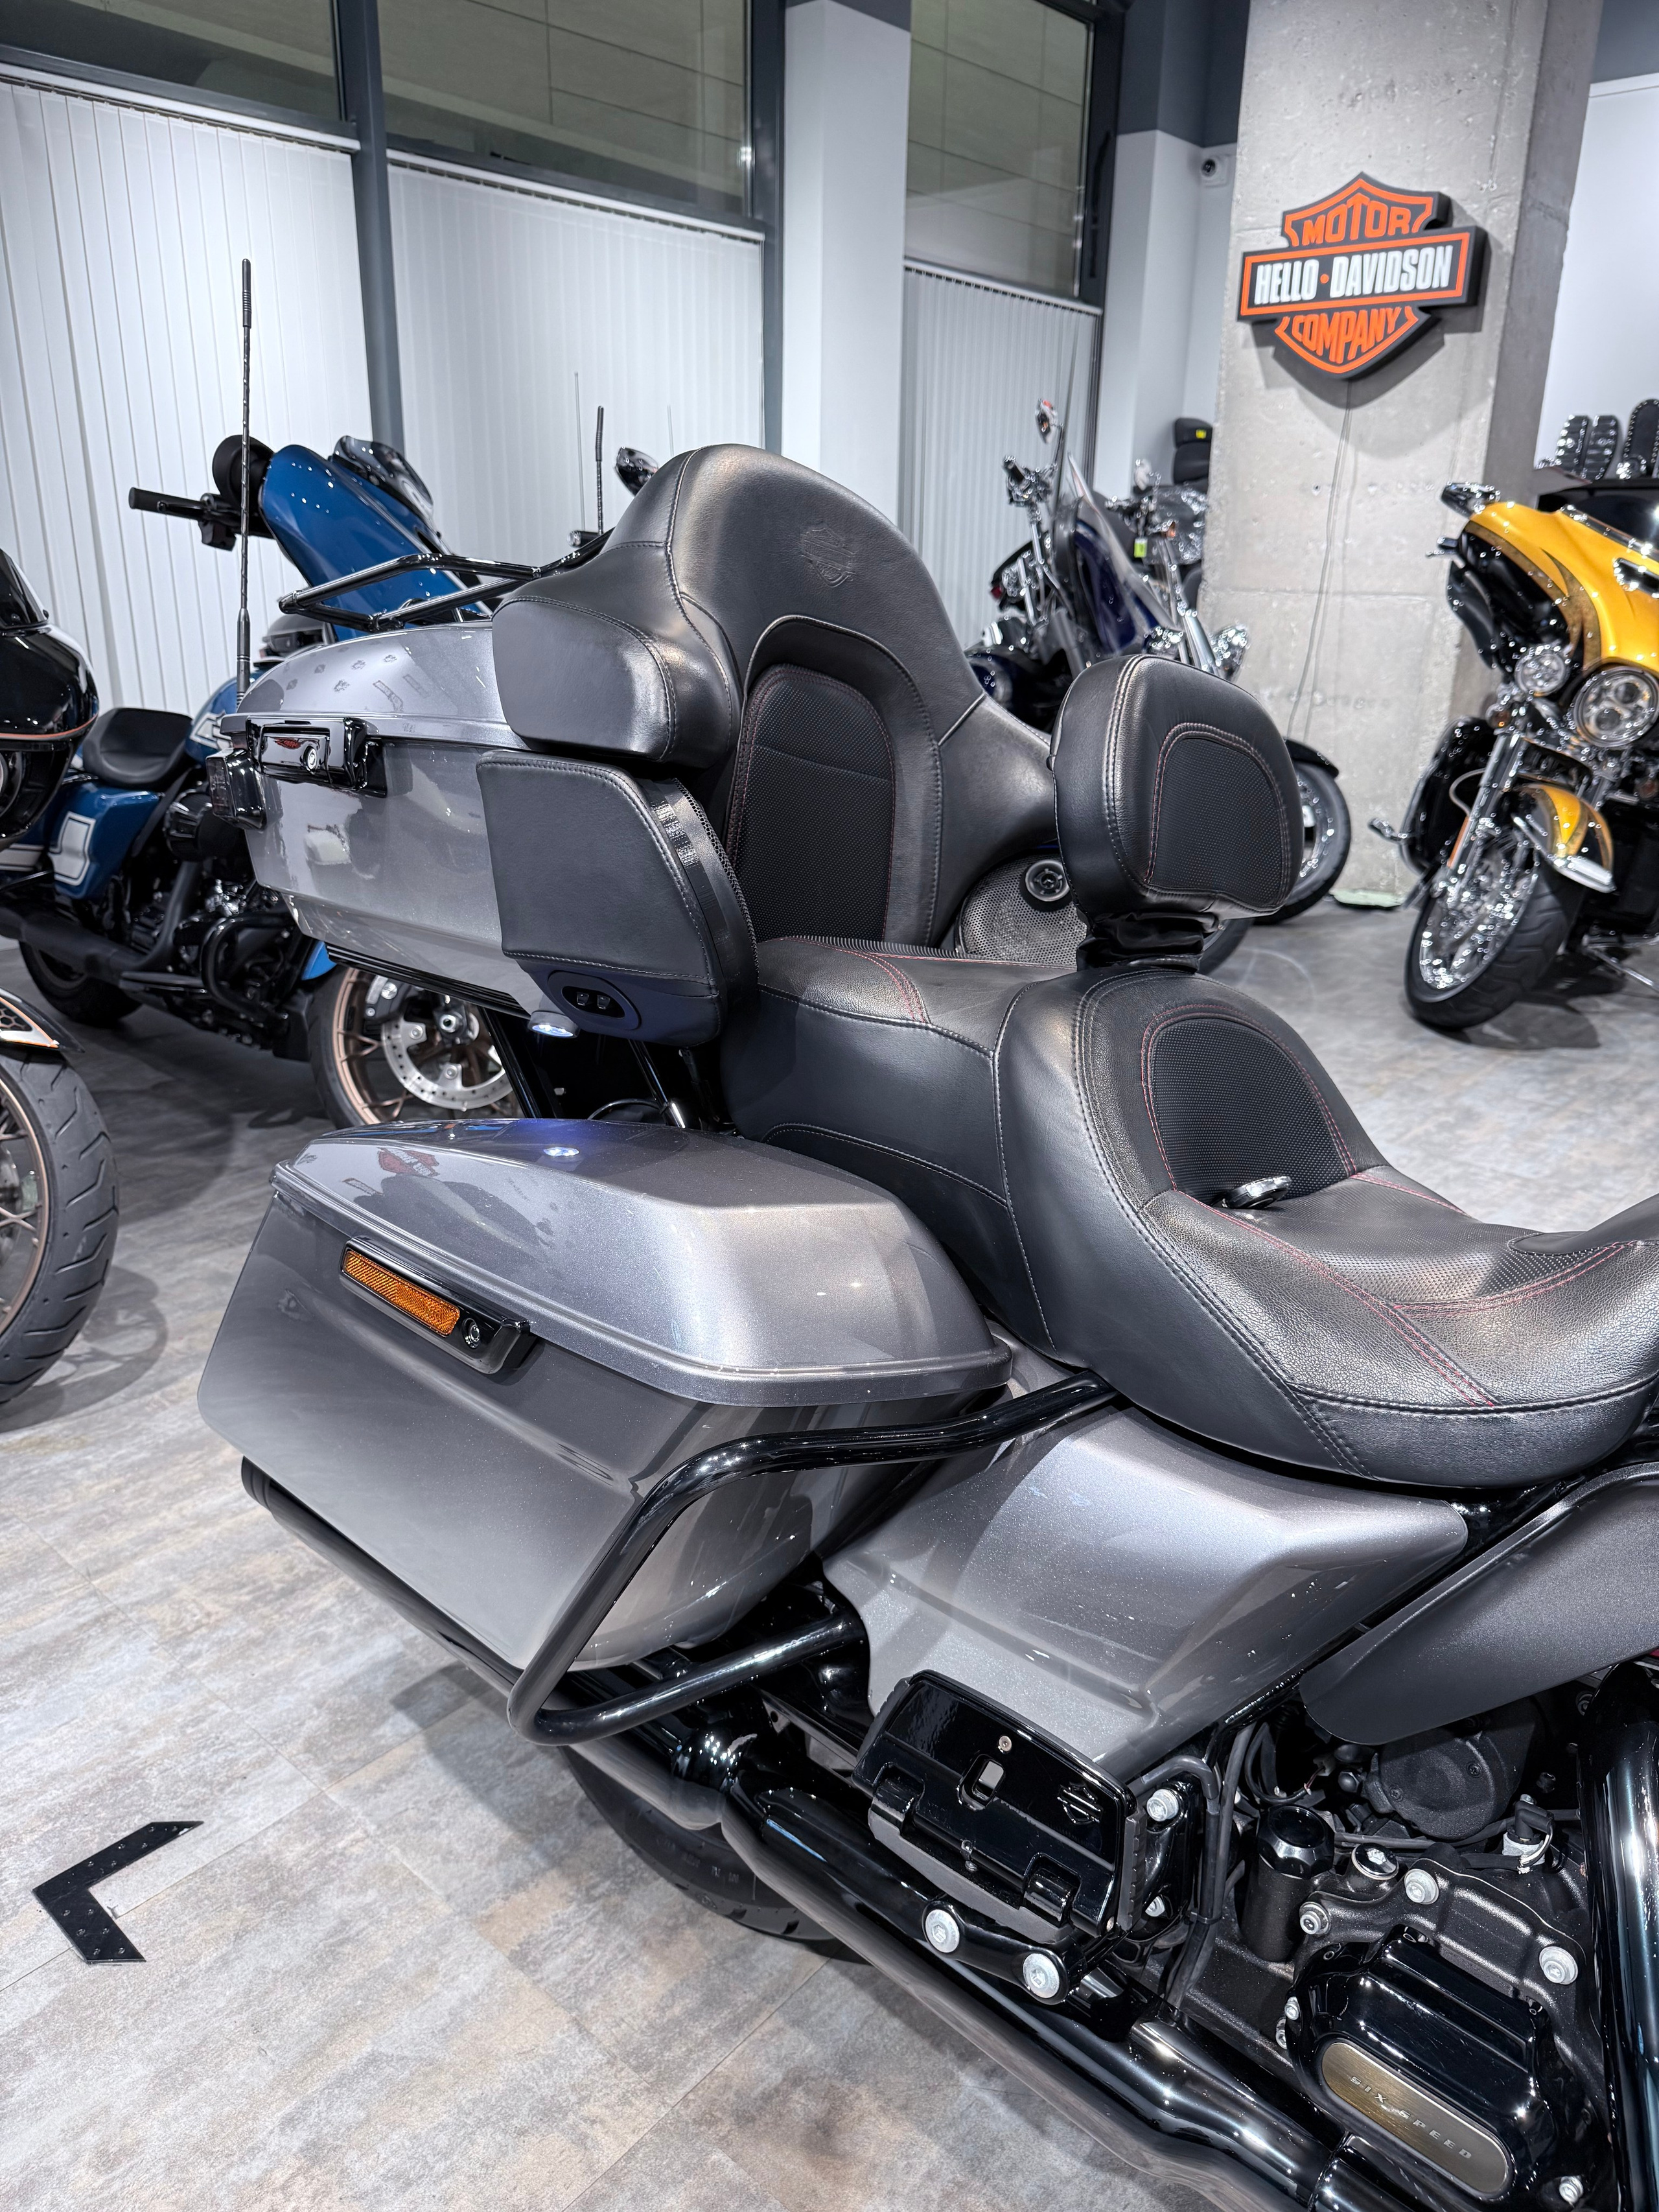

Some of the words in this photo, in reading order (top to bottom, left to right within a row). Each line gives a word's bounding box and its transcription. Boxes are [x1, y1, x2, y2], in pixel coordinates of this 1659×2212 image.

[1301, 192, 1411, 246] MOTOR
[1254, 259, 1319, 305] HELLO
[1330, 245, 1454, 298] DAVIDSON
[1292, 307, 1402, 364] COMPANY
[1350, 2076, 1387, 2104] SIX
[1400, 2110, 1472, 2160] SPEED
